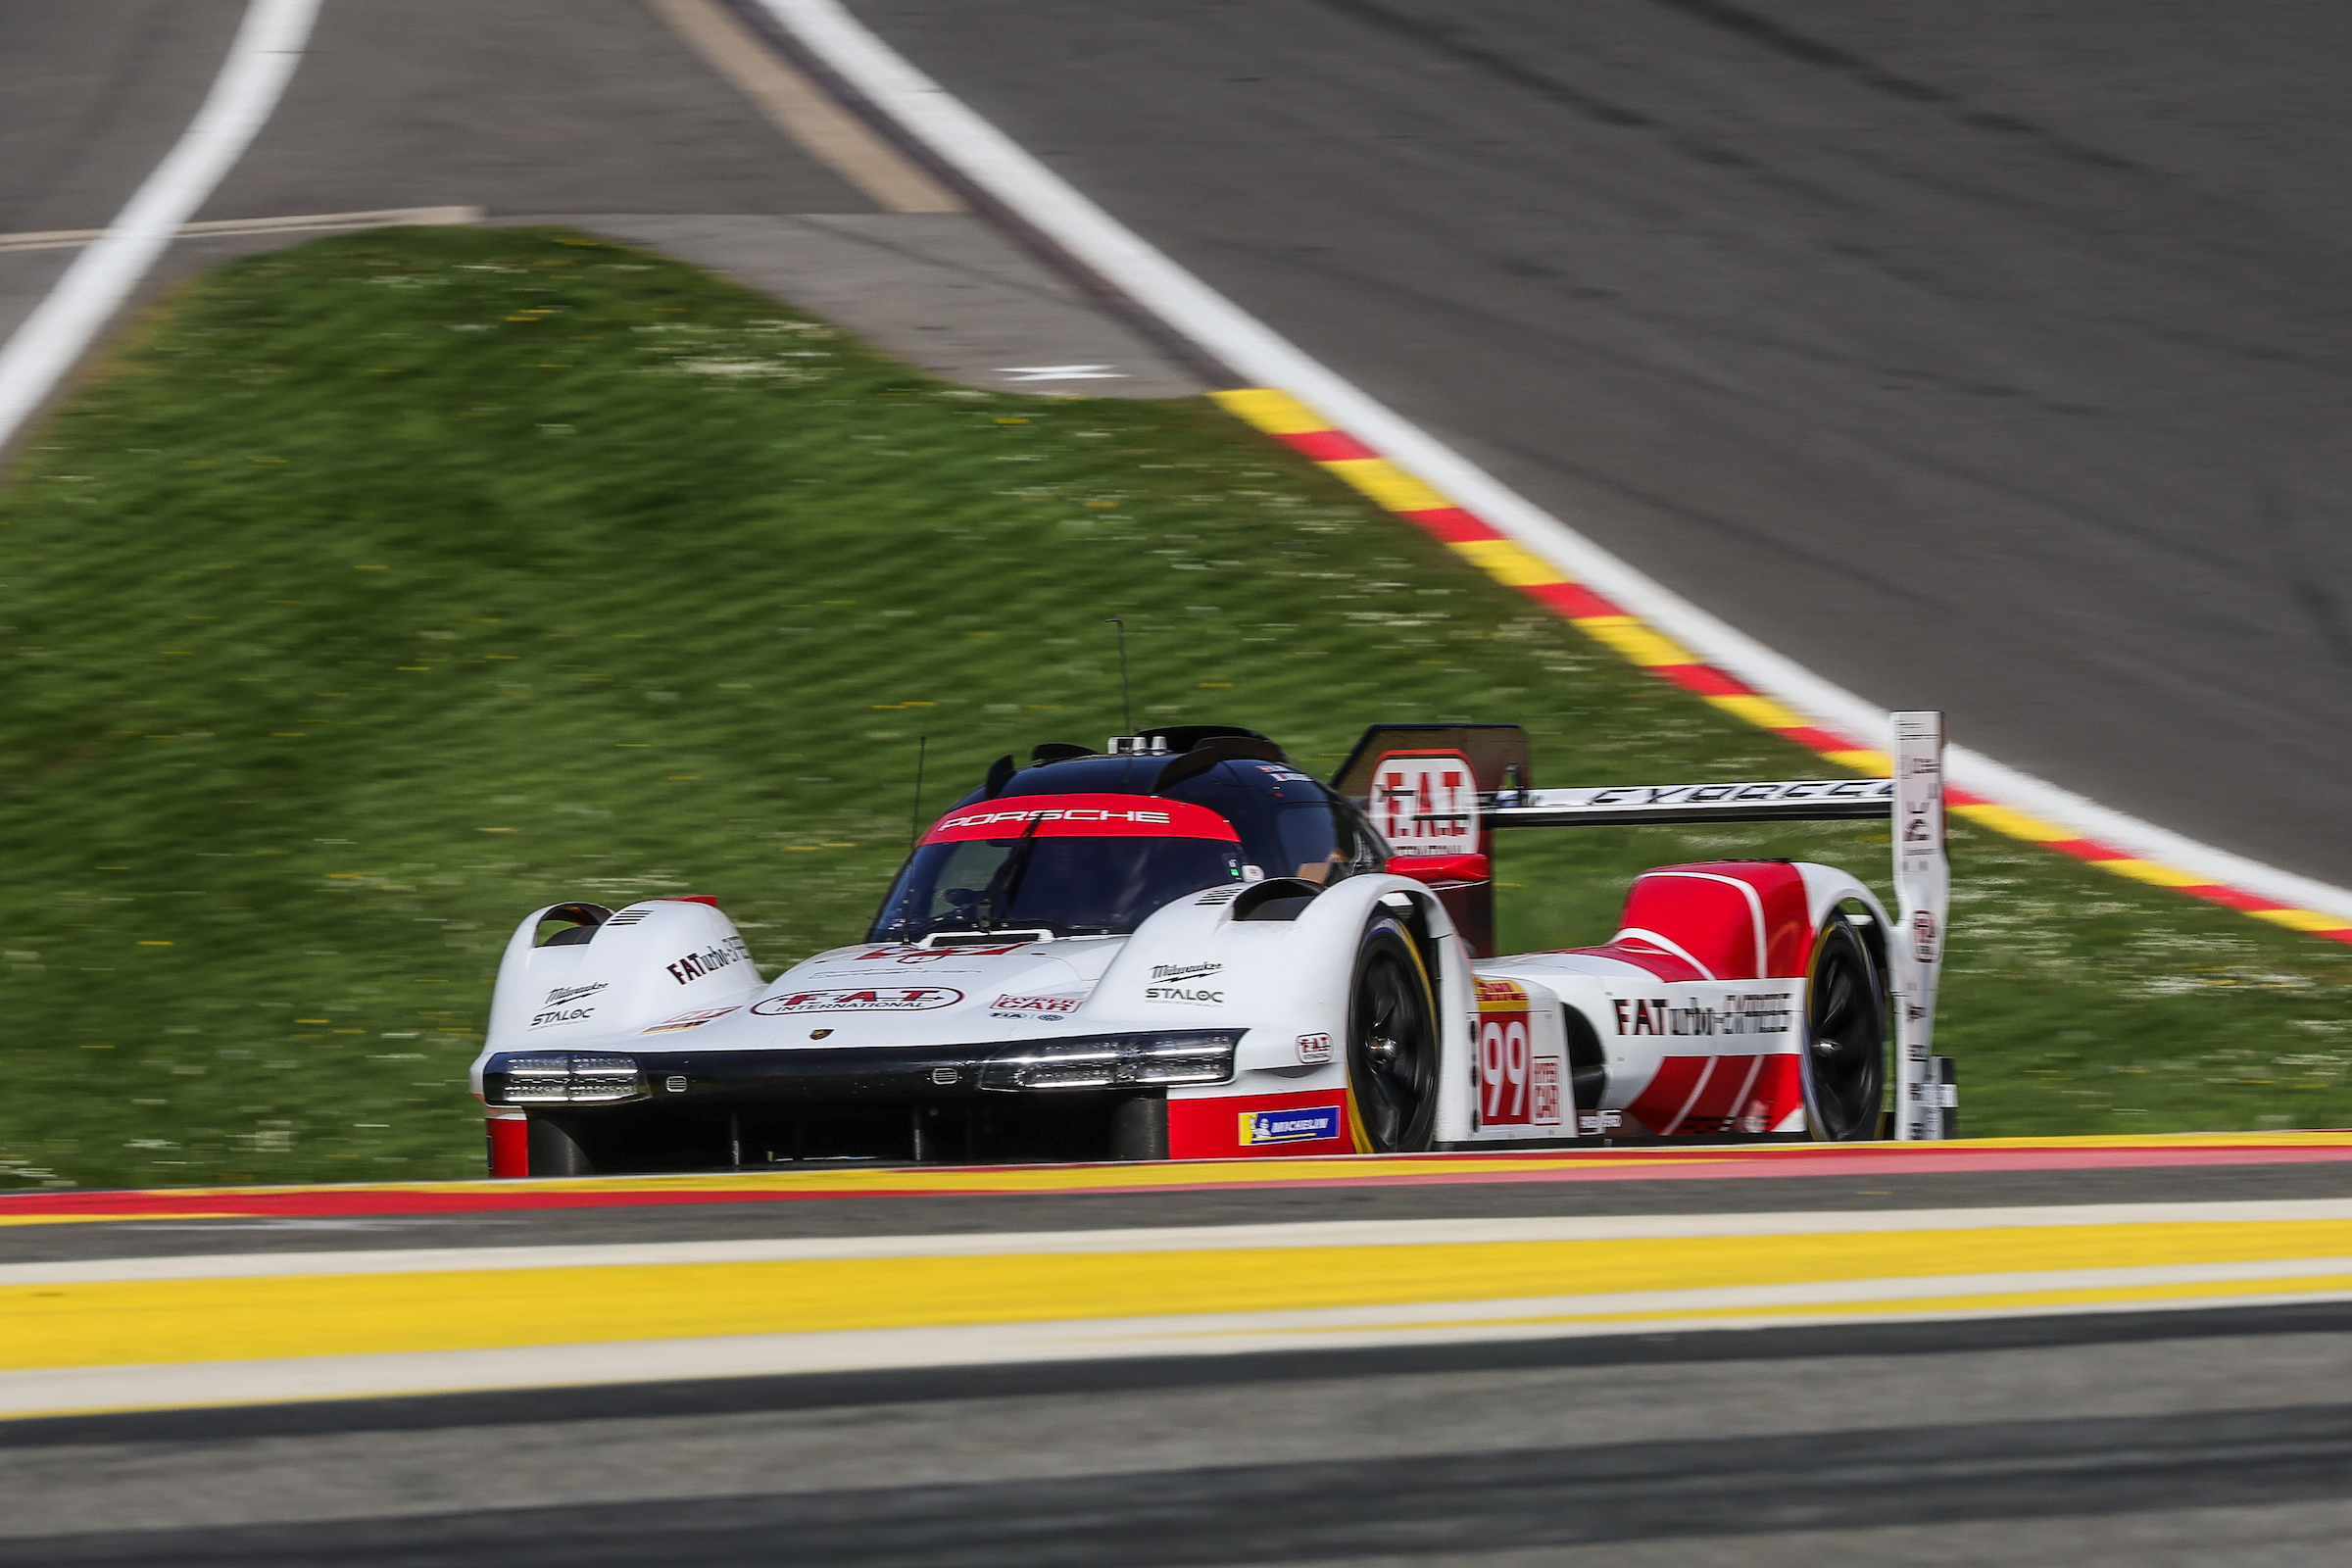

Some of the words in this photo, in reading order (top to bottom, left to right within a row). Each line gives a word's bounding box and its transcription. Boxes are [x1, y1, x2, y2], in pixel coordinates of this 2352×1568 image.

[937, 808, 1171, 832] PORSCHE
[1144, 987, 1225, 1004] STALOC
[774, 1002, 927, 1013] INTERNATIONAL
[997, 1000, 1072, 1011] CAR
[529, 1006, 596, 1027] STALOC
[1482, 1020, 1528, 1117] 99
[1270, 1117, 1330, 1134] MICHELIN
